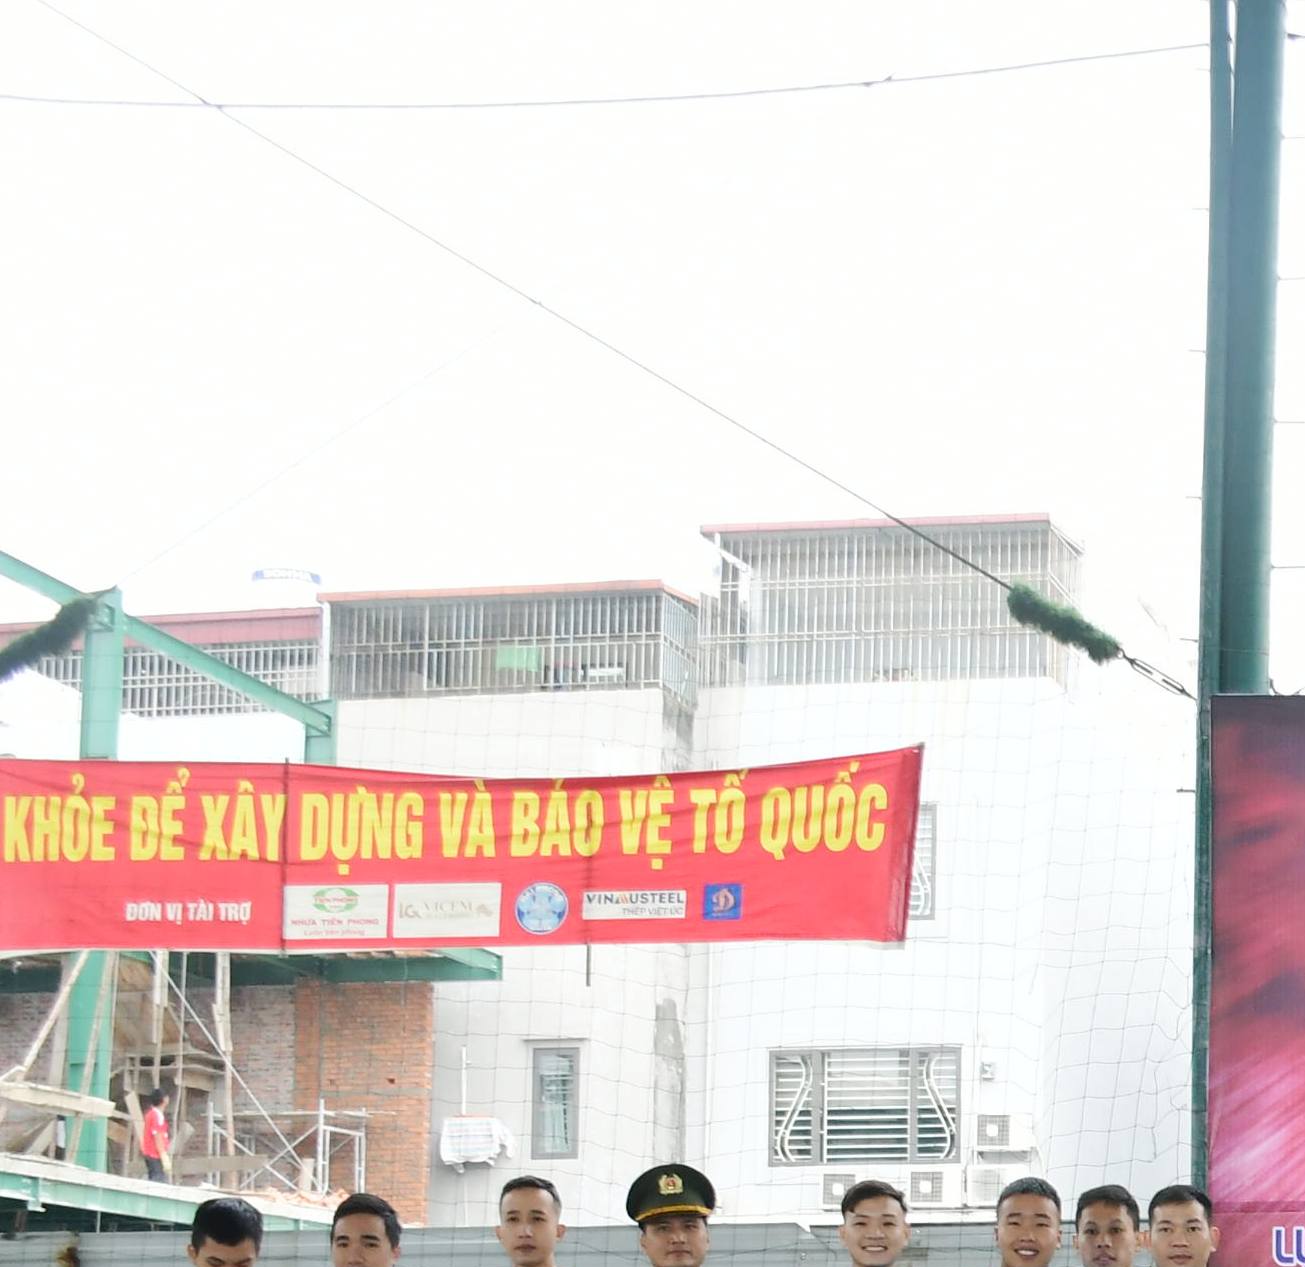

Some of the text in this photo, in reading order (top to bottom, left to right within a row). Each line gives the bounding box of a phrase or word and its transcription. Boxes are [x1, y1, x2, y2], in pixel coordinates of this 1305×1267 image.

[4, 773, 116, 862] KHỎE
[130, 767, 190, 861] ĐỂ
[200, 780, 287, 861] XÂY
[303, 785, 425, 875] DỰNG
[439, 779, 496, 858] VÀ
[619, 775, 675, 870] VỆ
[760, 761, 888, 860] QUỐC
[125, 898, 252, 925] ĐƠN VỊ TÀI TRỢ
